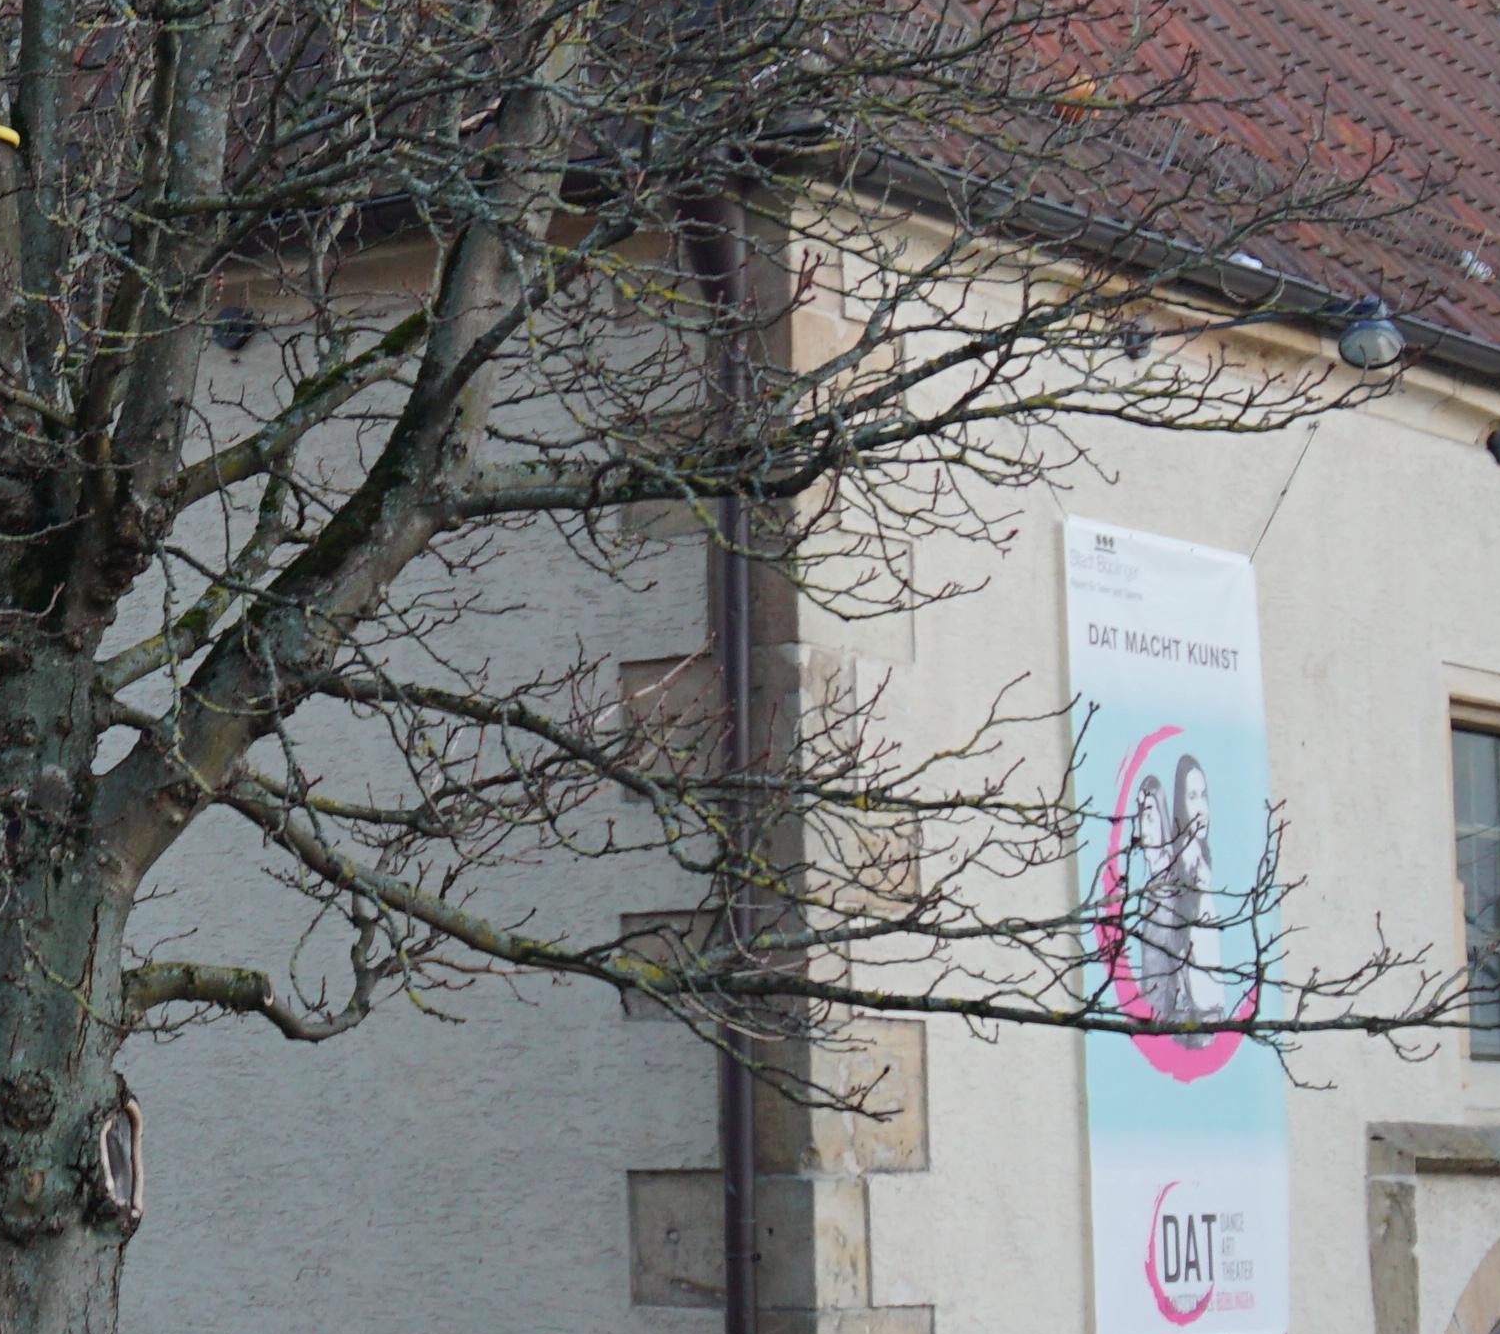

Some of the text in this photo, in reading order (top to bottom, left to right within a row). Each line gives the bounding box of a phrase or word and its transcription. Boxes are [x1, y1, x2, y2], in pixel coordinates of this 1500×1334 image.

[1088, 623, 1239, 671] DAT MACHT KUNST
[1162, 1214, 1217, 1283] DAT
